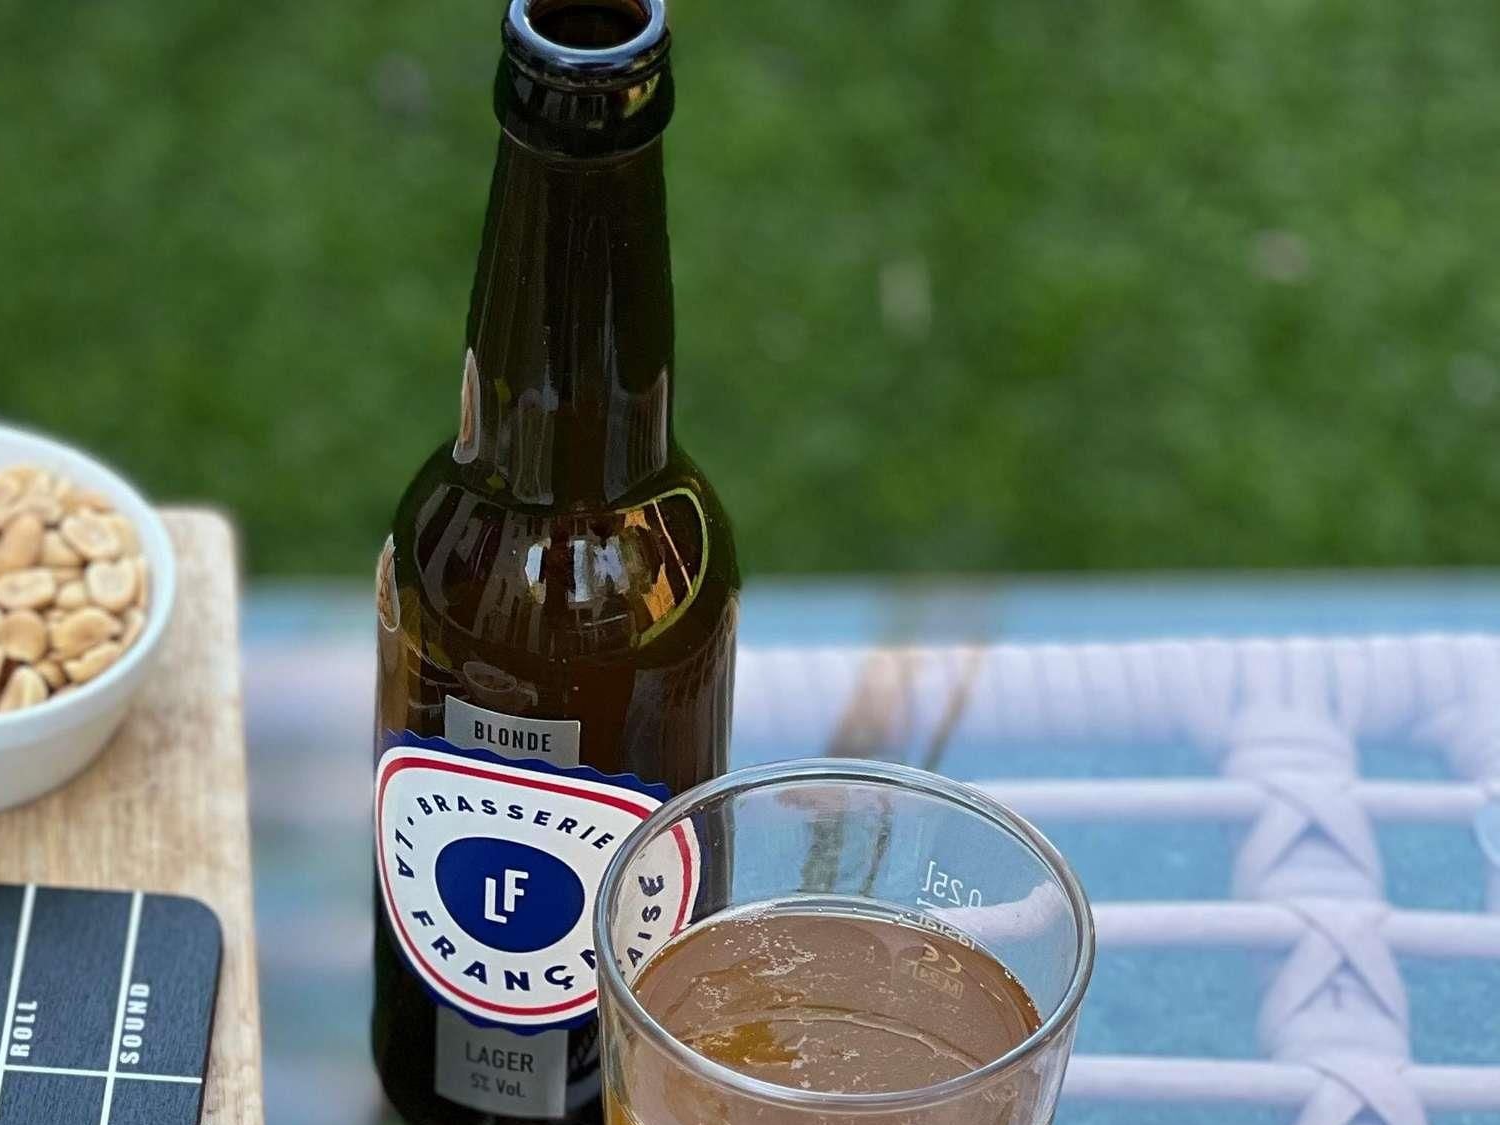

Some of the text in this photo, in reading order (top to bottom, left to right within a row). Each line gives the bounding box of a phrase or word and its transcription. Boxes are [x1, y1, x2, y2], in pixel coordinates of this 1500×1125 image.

[474, 720, 552, 752] BLONDE
[417, 793, 615, 850] BRASSERIE
[395, 829, 415, 879] LA
[484, 869, 529, 924] LF
[9, 1000, 38, 1057] ROLL
[119, 983, 150, 1065] SOUND
[465, 1041, 534, 1073] LAGER
